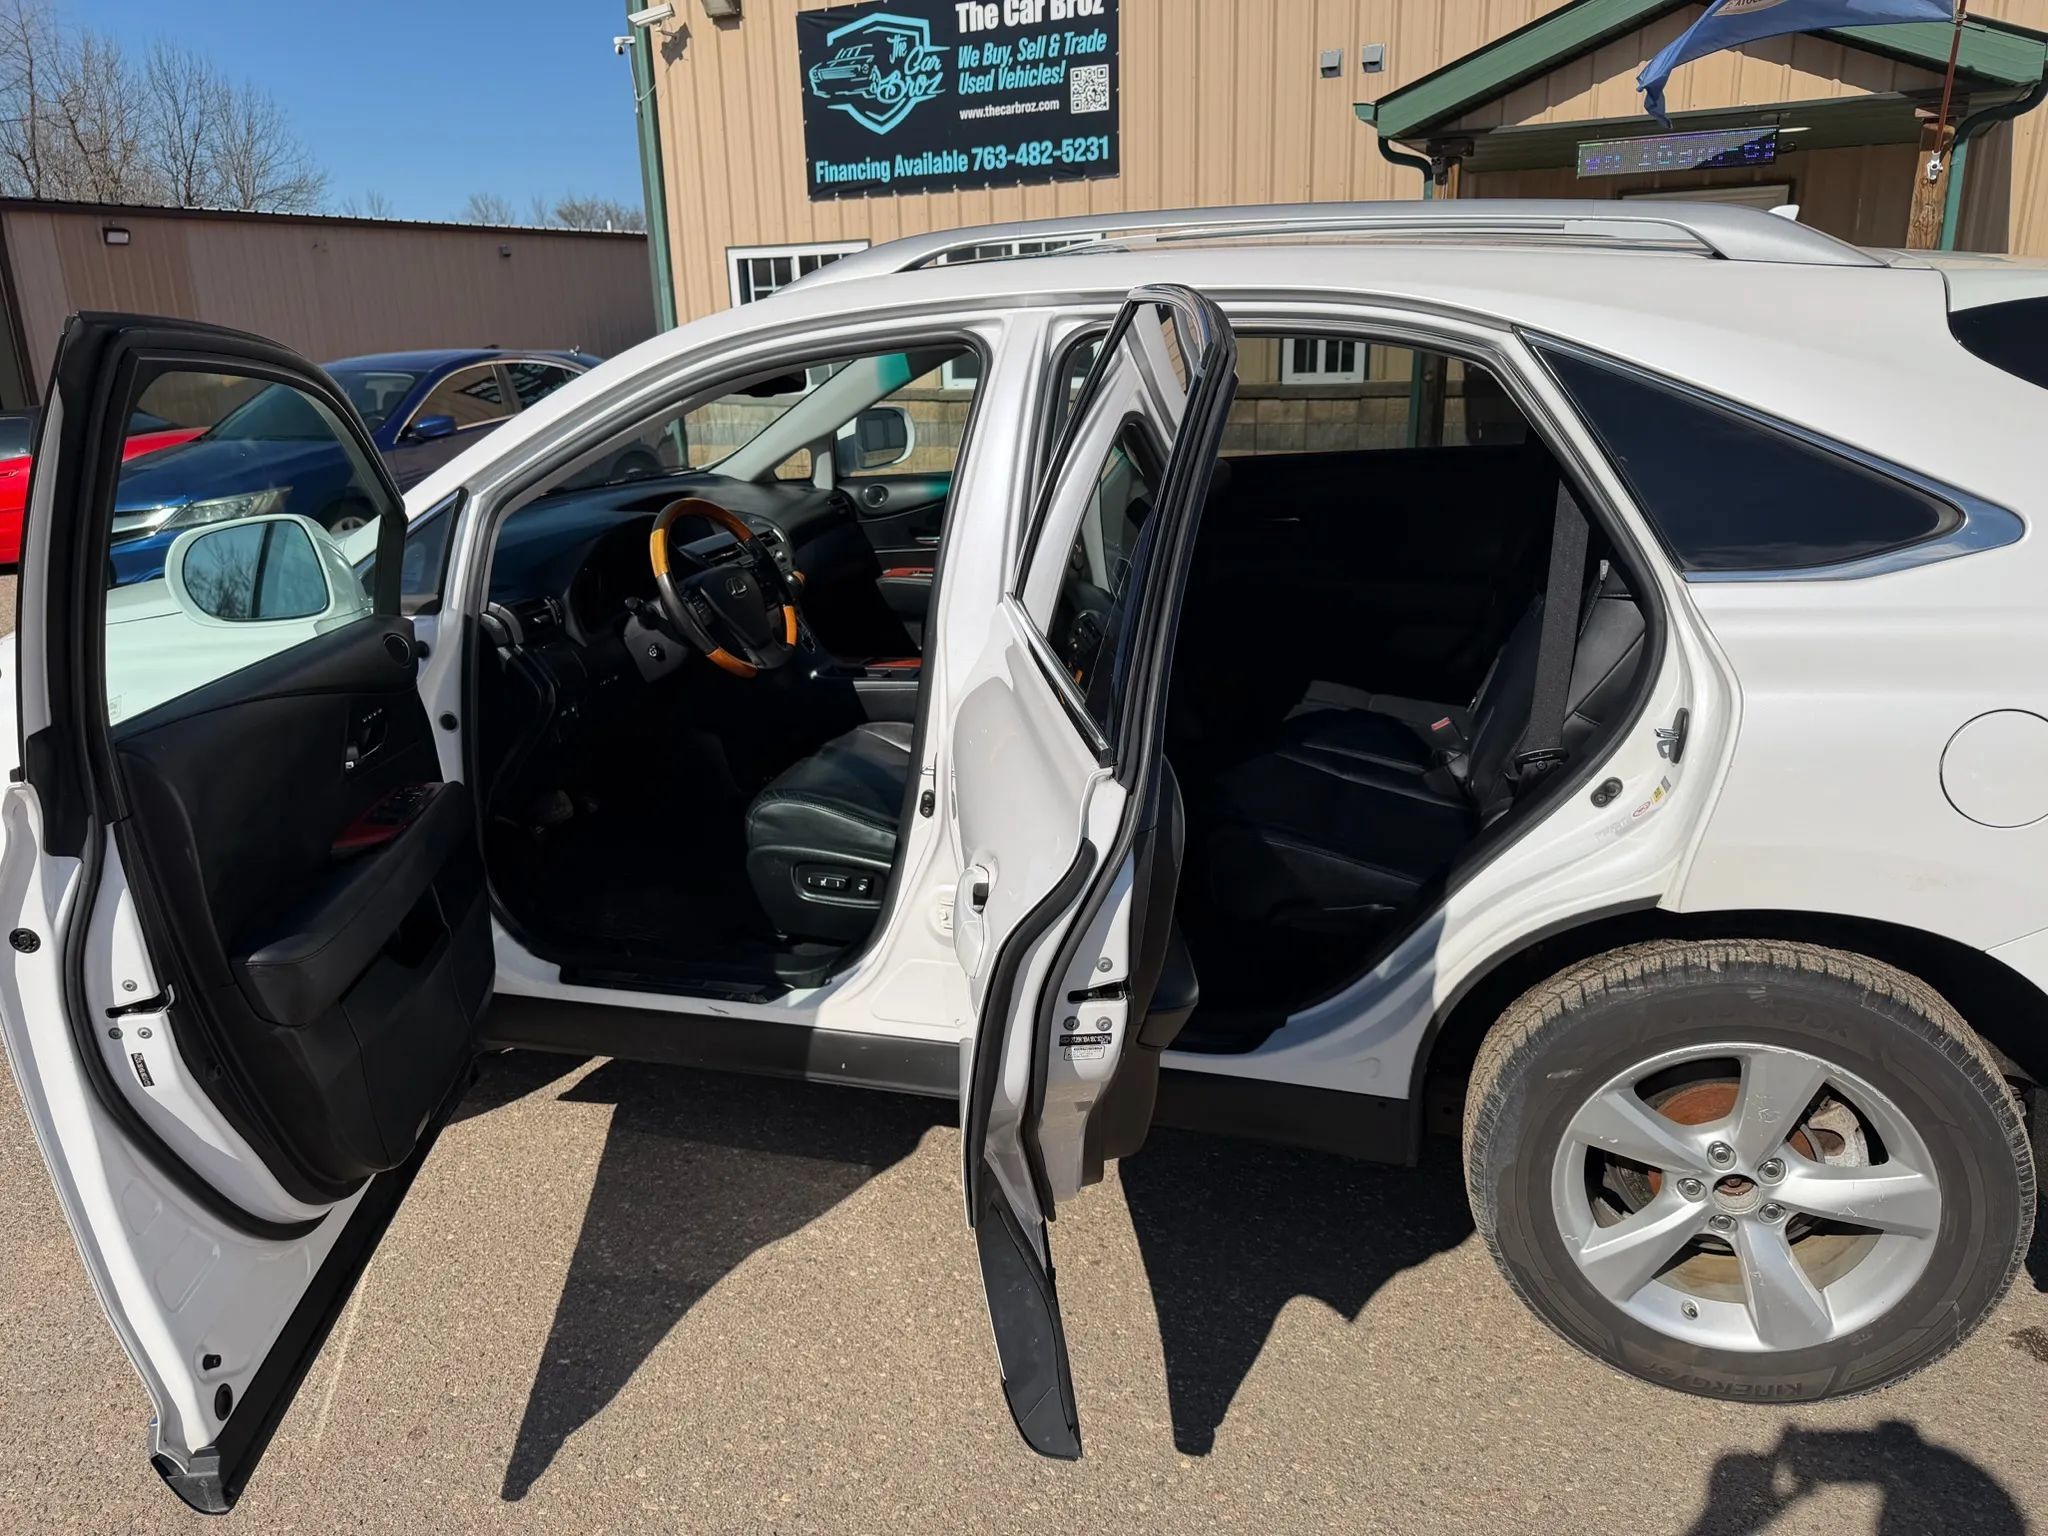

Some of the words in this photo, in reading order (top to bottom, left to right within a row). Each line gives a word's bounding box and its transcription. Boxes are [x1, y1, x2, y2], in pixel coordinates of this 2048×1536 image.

[955, 1, 999, 33] The
[1003, 0, 1045, 27] Car
[1050, 0, 1105, 21] Broz
[904, 45, 942, 75] Car
[957, 45, 980, 69] We
[982, 42, 1013, 68] Buy,
[1016, 35, 1047, 61] Sell
[1048, 33, 1061, 57] &
[1064, 28, 1108, 56] Trade
[958, 69, 996, 95] Used
[998, 60, 1067, 90] Vehicles!
[959, 100, 1060, 120] www.thecarbroz.com
[815, 156, 891, 183] Financing
[894, 149, 969, 178] Available
[971, 135, 1109, 171] 763-482-5231
